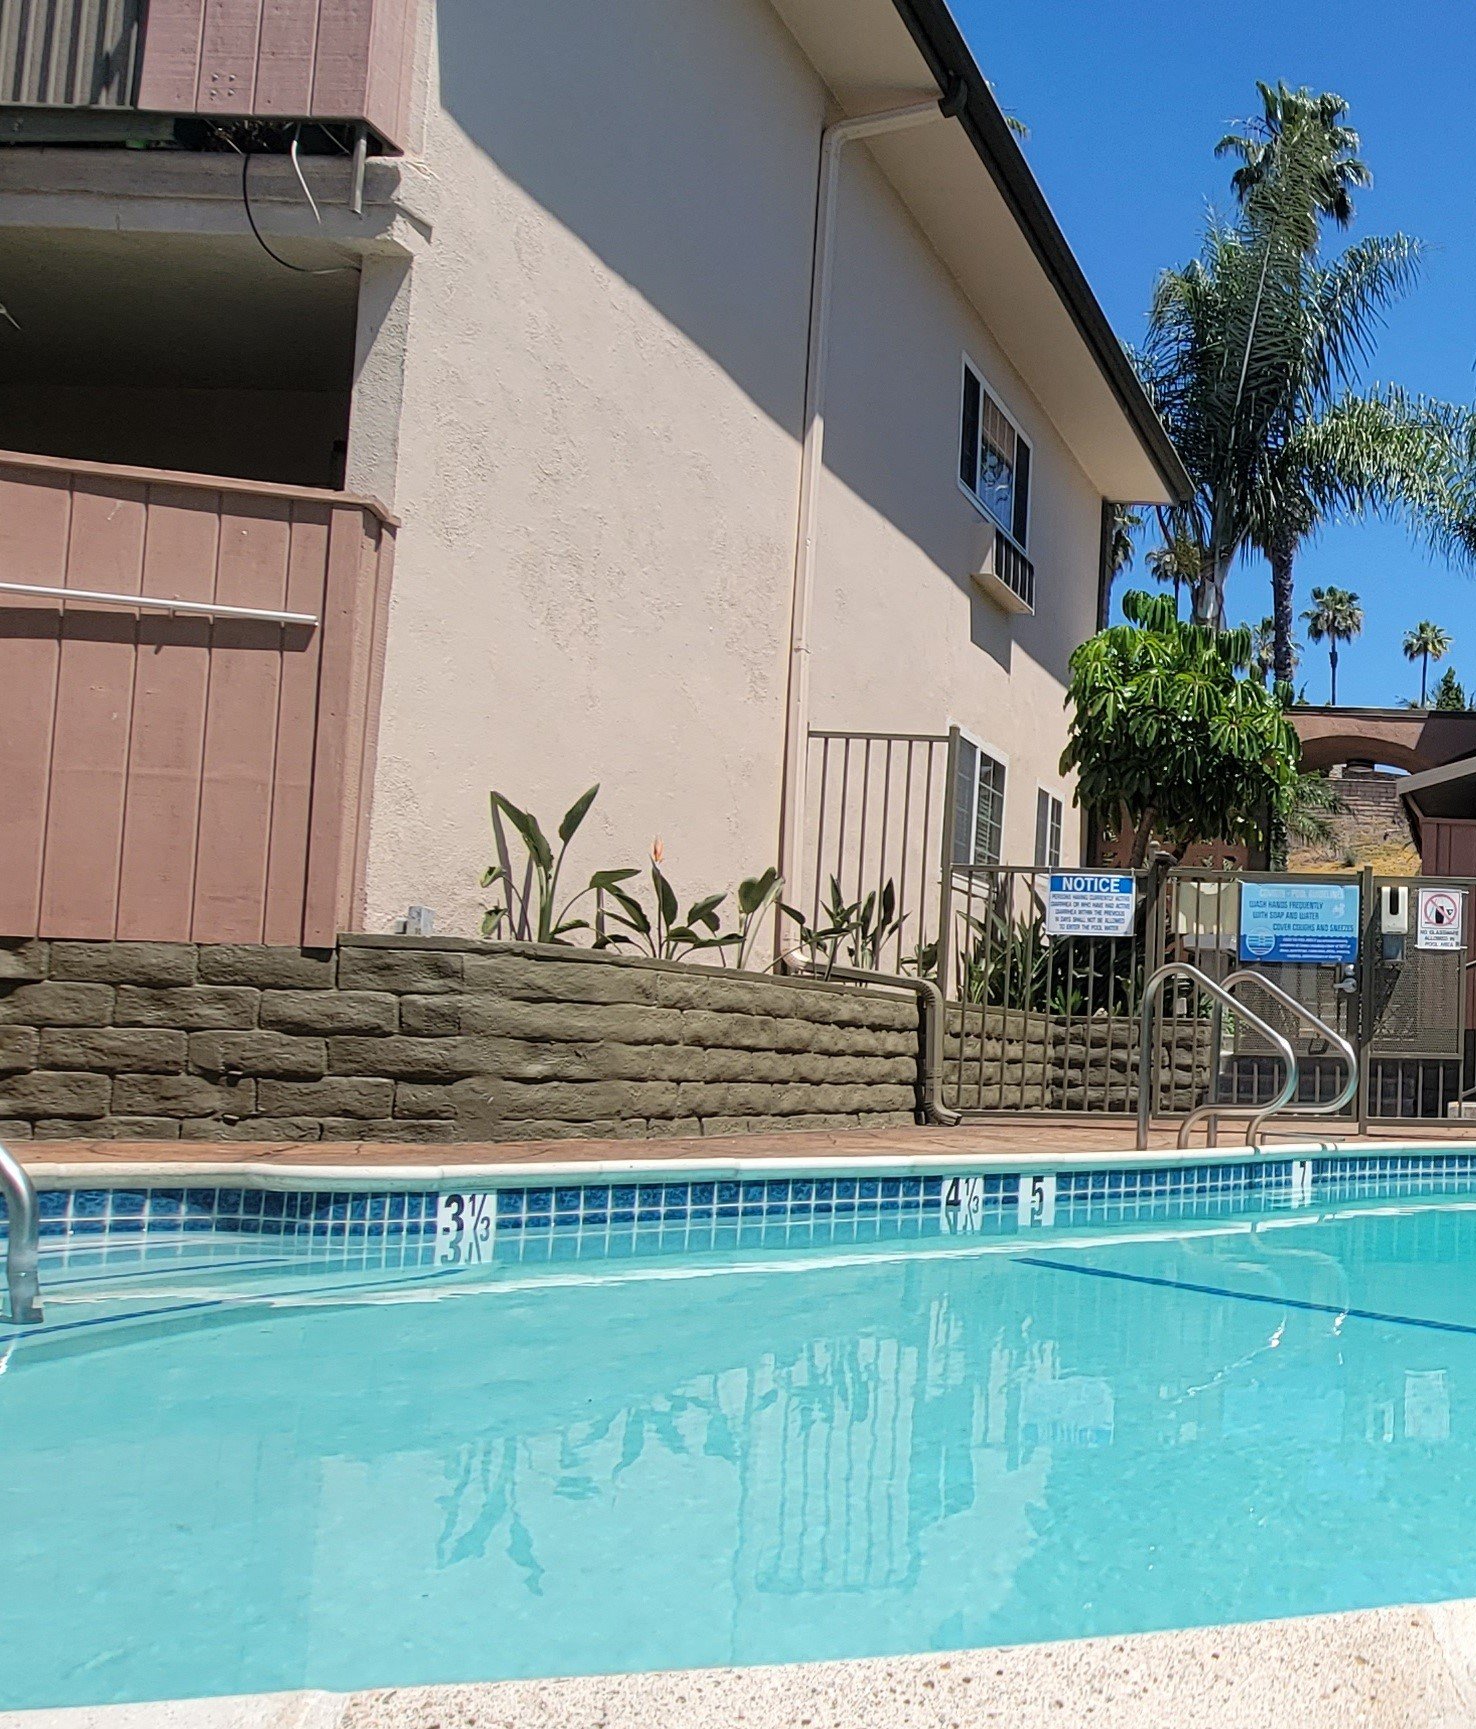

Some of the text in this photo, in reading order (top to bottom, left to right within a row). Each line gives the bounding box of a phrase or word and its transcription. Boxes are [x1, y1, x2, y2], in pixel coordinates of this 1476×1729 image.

[1062, 877, 1120, 893] NOTICE
[1268, 901, 1288, 909] HANDS
[1289, 901, 1323, 909] FREQUENTLY
[1253, 911, 1320, 920] WITH SOAP AND WATER
[1272, 923, 1290, 931] COVER
[1292, 923, 1316, 932] COUGHS
[1316, 924, 1329, 932] AND
[946, 1177, 961, 1206] 4
[1031, 1176, 1044, 1205] 5
[443, 1193, 465, 1234] 3
